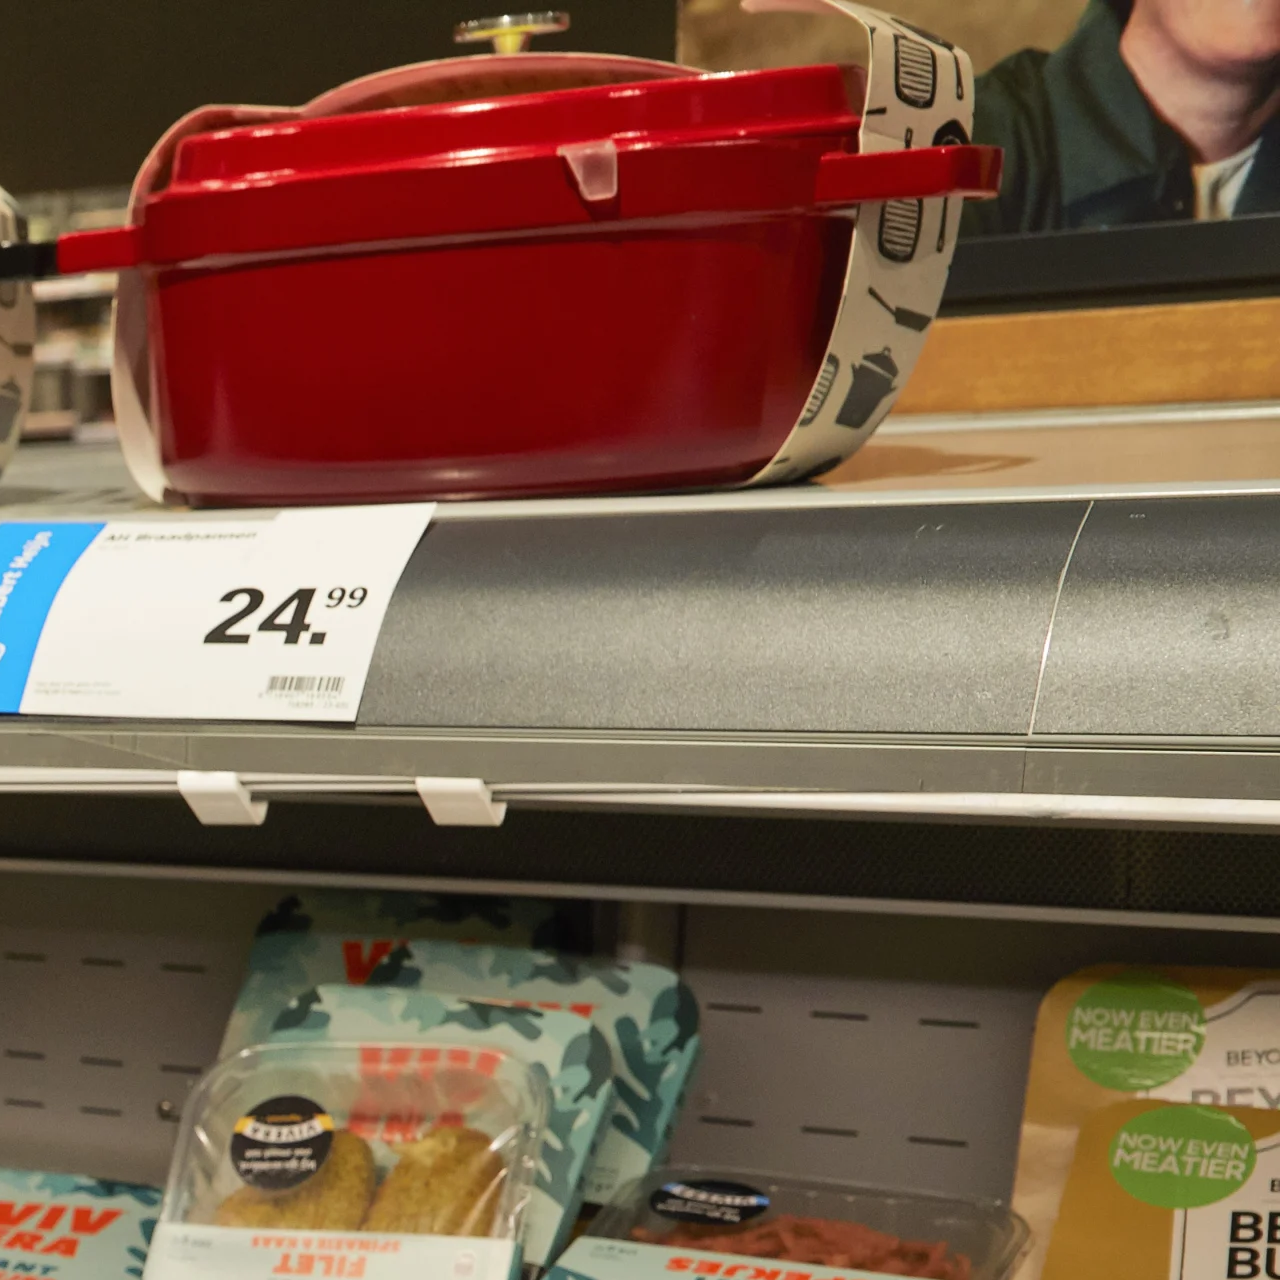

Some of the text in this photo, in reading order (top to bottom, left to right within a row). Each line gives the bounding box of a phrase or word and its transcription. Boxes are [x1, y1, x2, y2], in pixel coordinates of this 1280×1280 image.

[8, 530, 53, 571] Heijn
[203, 586, 368, 645] 24.99
[1071, 1006, 1199, 1033] NOW EVEN
[1069, 1027, 1198, 1056] MEATIER
[1117, 1131, 1250, 1159] NOW EVEN
[1112, 1148, 1247, 1181] MEATIER
[272, 1252, 367, 1279] FILET
